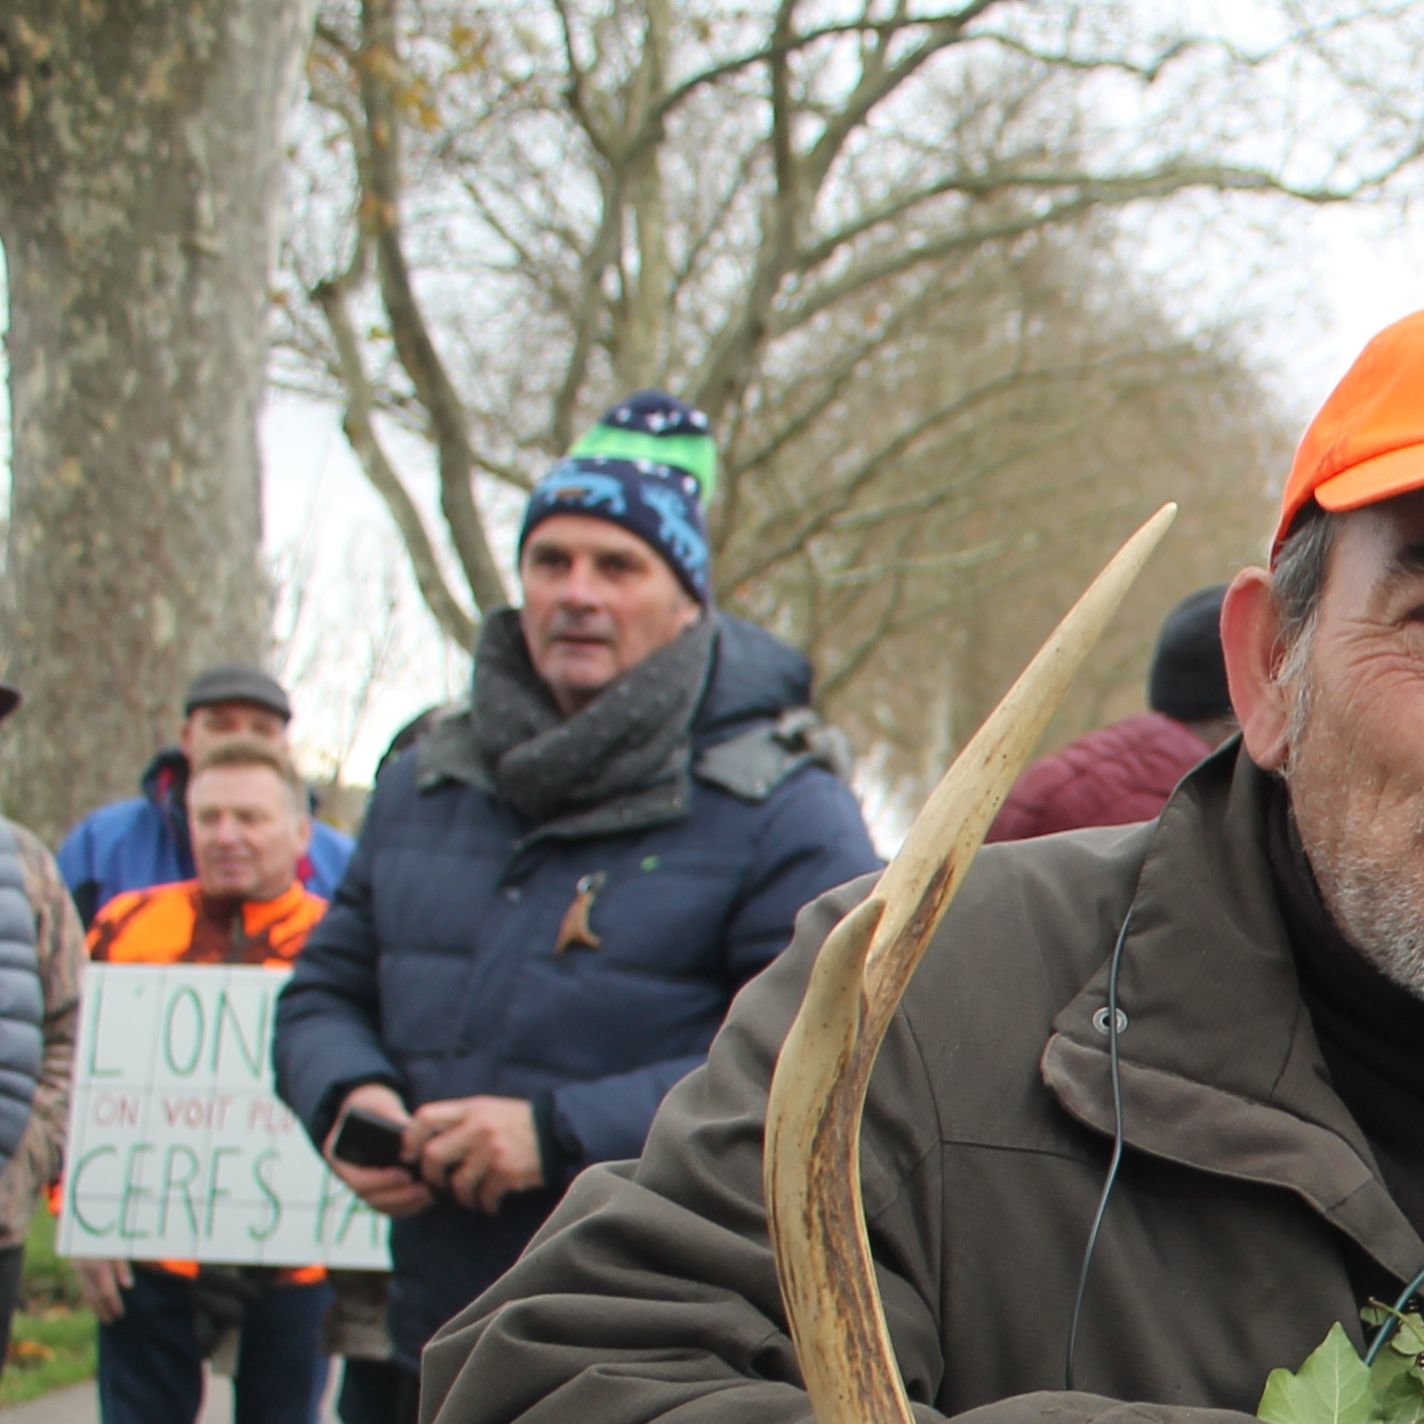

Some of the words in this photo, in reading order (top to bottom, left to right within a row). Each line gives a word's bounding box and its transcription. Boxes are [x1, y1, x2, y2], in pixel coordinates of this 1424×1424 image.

[93, 1094, 139, 1129] ON
[162, 1095, 234, 1129] VOIT
[71, 1143, 282, 1242] CERFS
